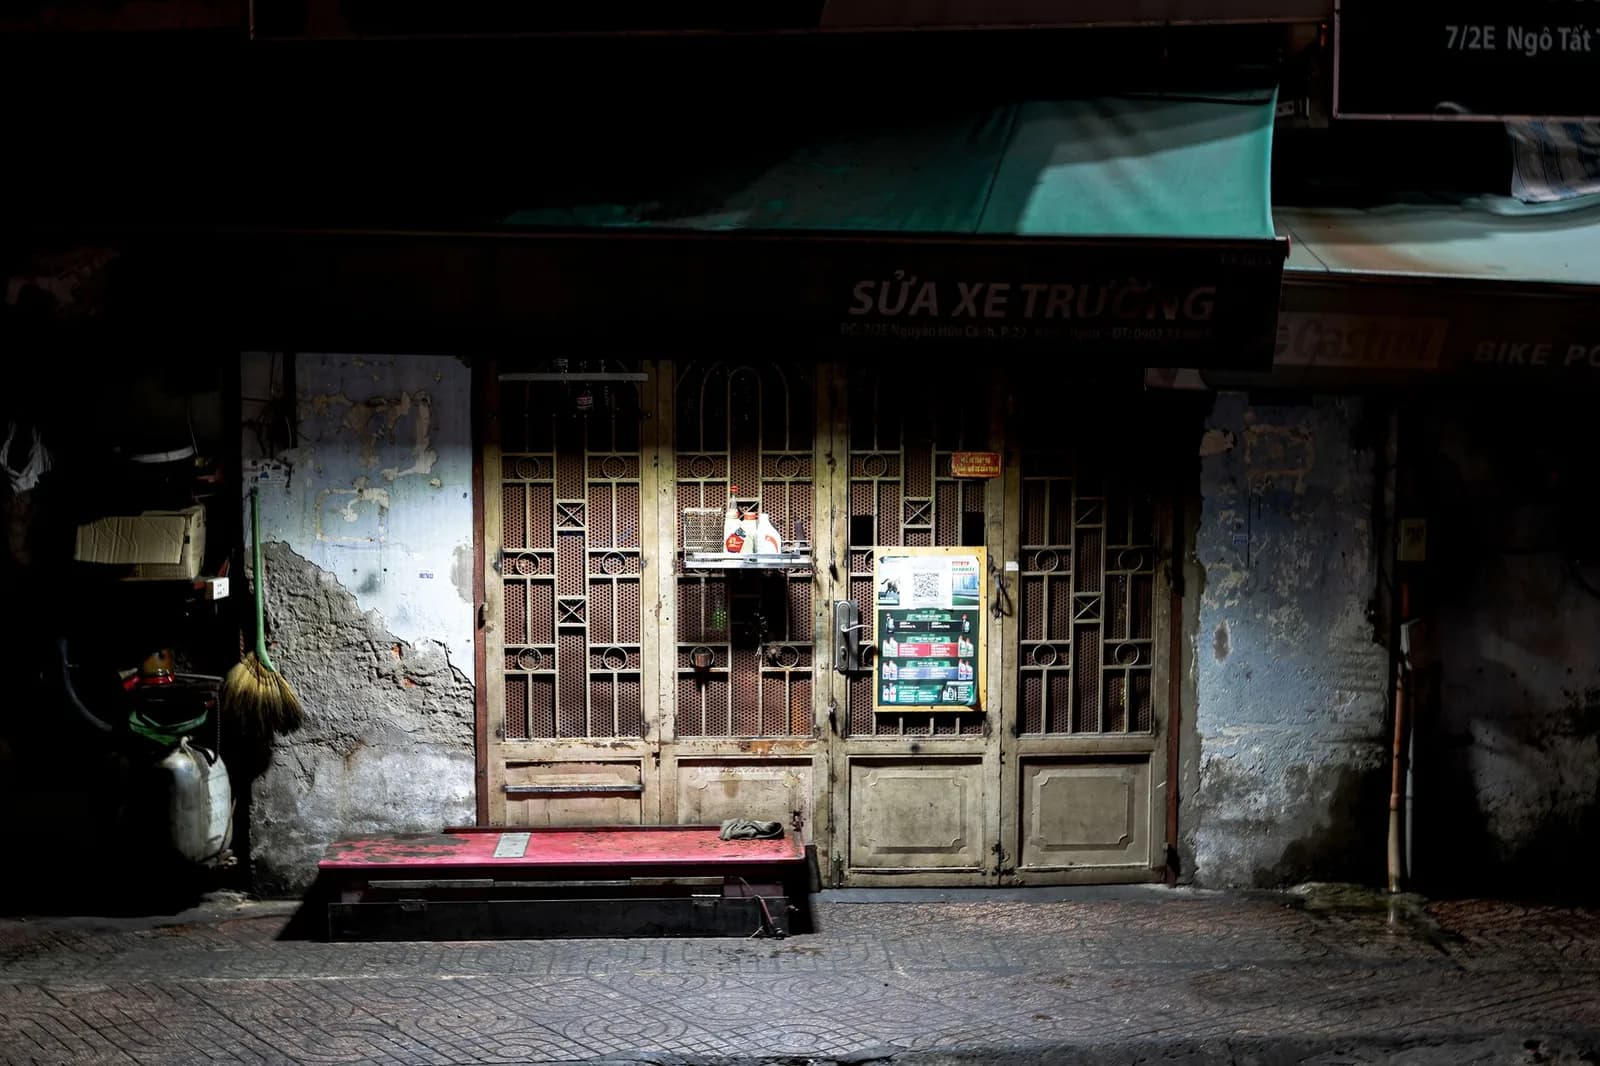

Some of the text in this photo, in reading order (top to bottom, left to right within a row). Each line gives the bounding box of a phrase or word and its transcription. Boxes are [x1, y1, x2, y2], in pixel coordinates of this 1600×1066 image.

[1445, 24, 1592, 56] 7/2E Ngô Tất
[848, 269, 939, 317] SỬA
[951, 281, 1011, 318] XE
[1474, 340, 1553, 366] BIKE
